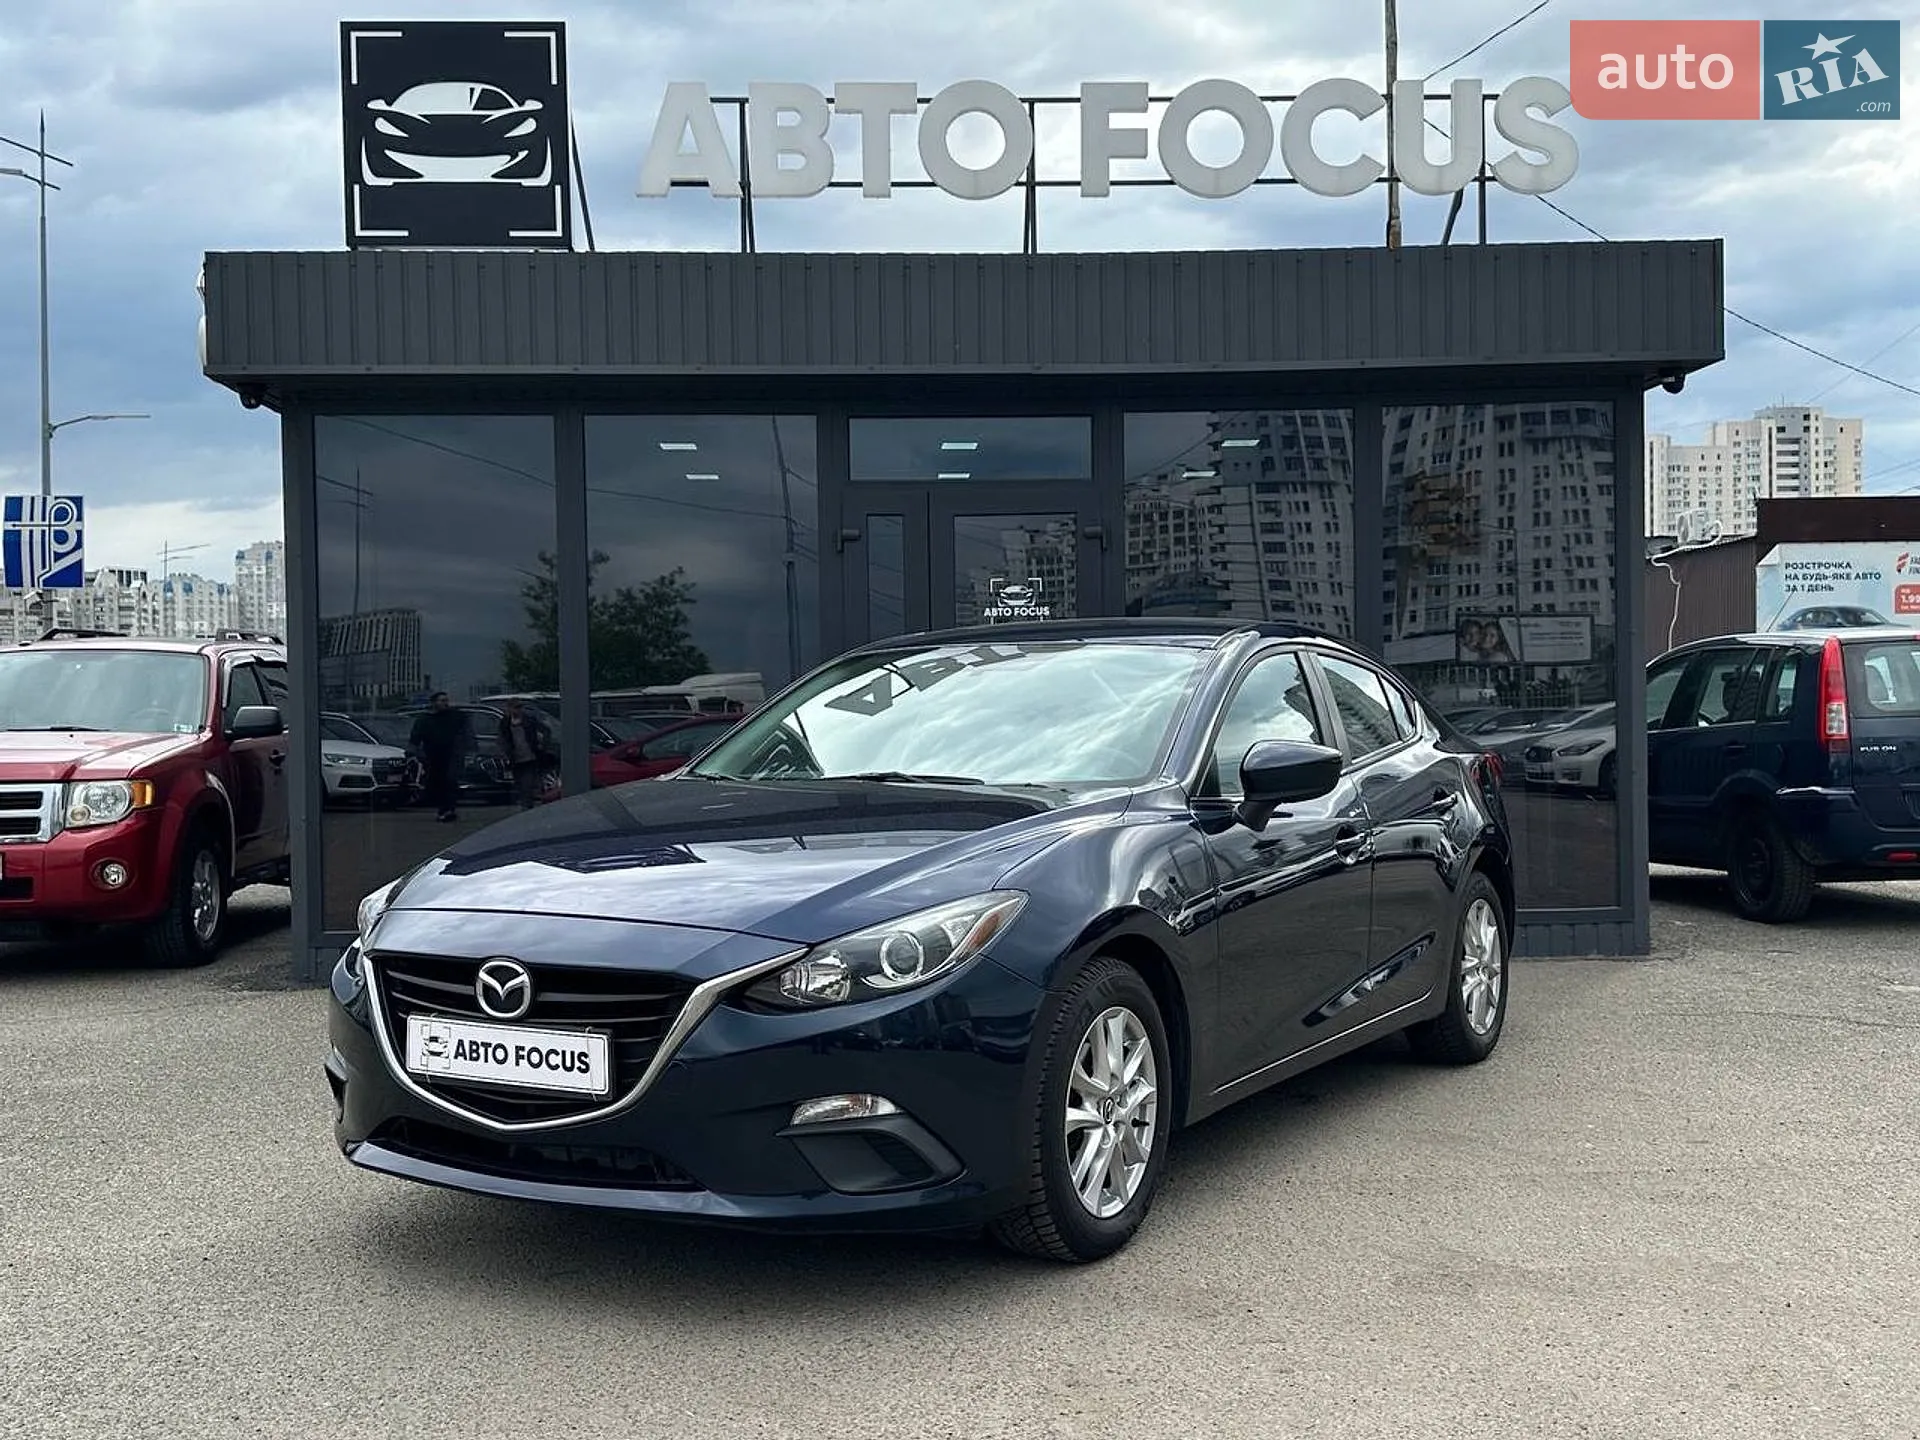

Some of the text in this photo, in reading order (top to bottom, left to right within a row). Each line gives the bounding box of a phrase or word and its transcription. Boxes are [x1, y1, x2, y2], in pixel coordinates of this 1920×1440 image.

[636, 76, 1579, 200] АВТО FOCUS
[1785, 562, 1852, 570] РОЗСТРОЧКА
[1785, 572, 1881, 581] НА БУДЬ-ЯКЕ АВТО
[1785, 584, 1798, 592] ЗА
[1807, 584, 1834, 592] ДЕНЬ
[1014, 606, 1050, 617] FOCUS
[514, 1045, 590, 1074] FOCUS
